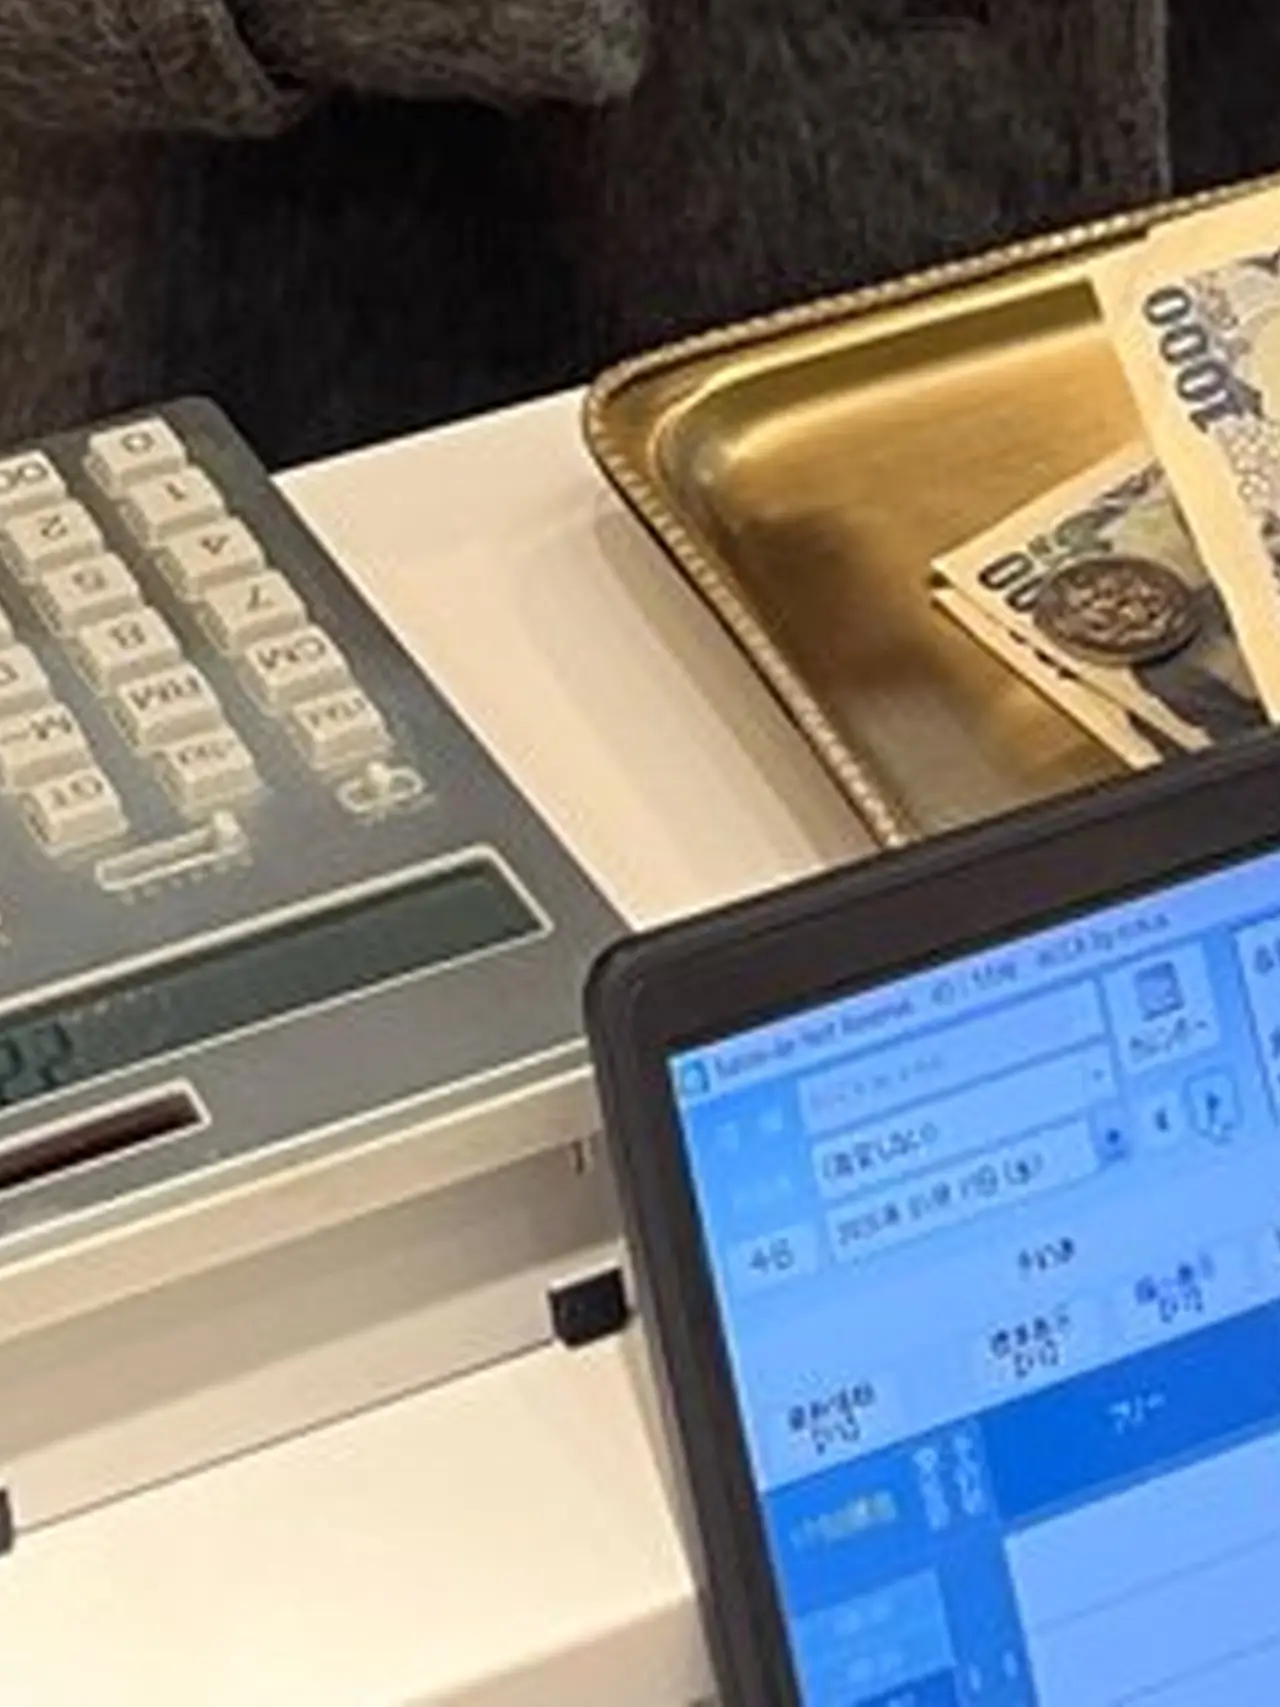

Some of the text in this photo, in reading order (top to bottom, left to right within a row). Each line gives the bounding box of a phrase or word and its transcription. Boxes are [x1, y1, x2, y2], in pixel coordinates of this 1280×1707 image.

[1142, 284, 1240, 433] 1000
[120, 430, 156, 454] 0
[39, 515, 70, 540] 2
[199, 534, 232, 557] 4
[245, 585, 274, 610] 7
